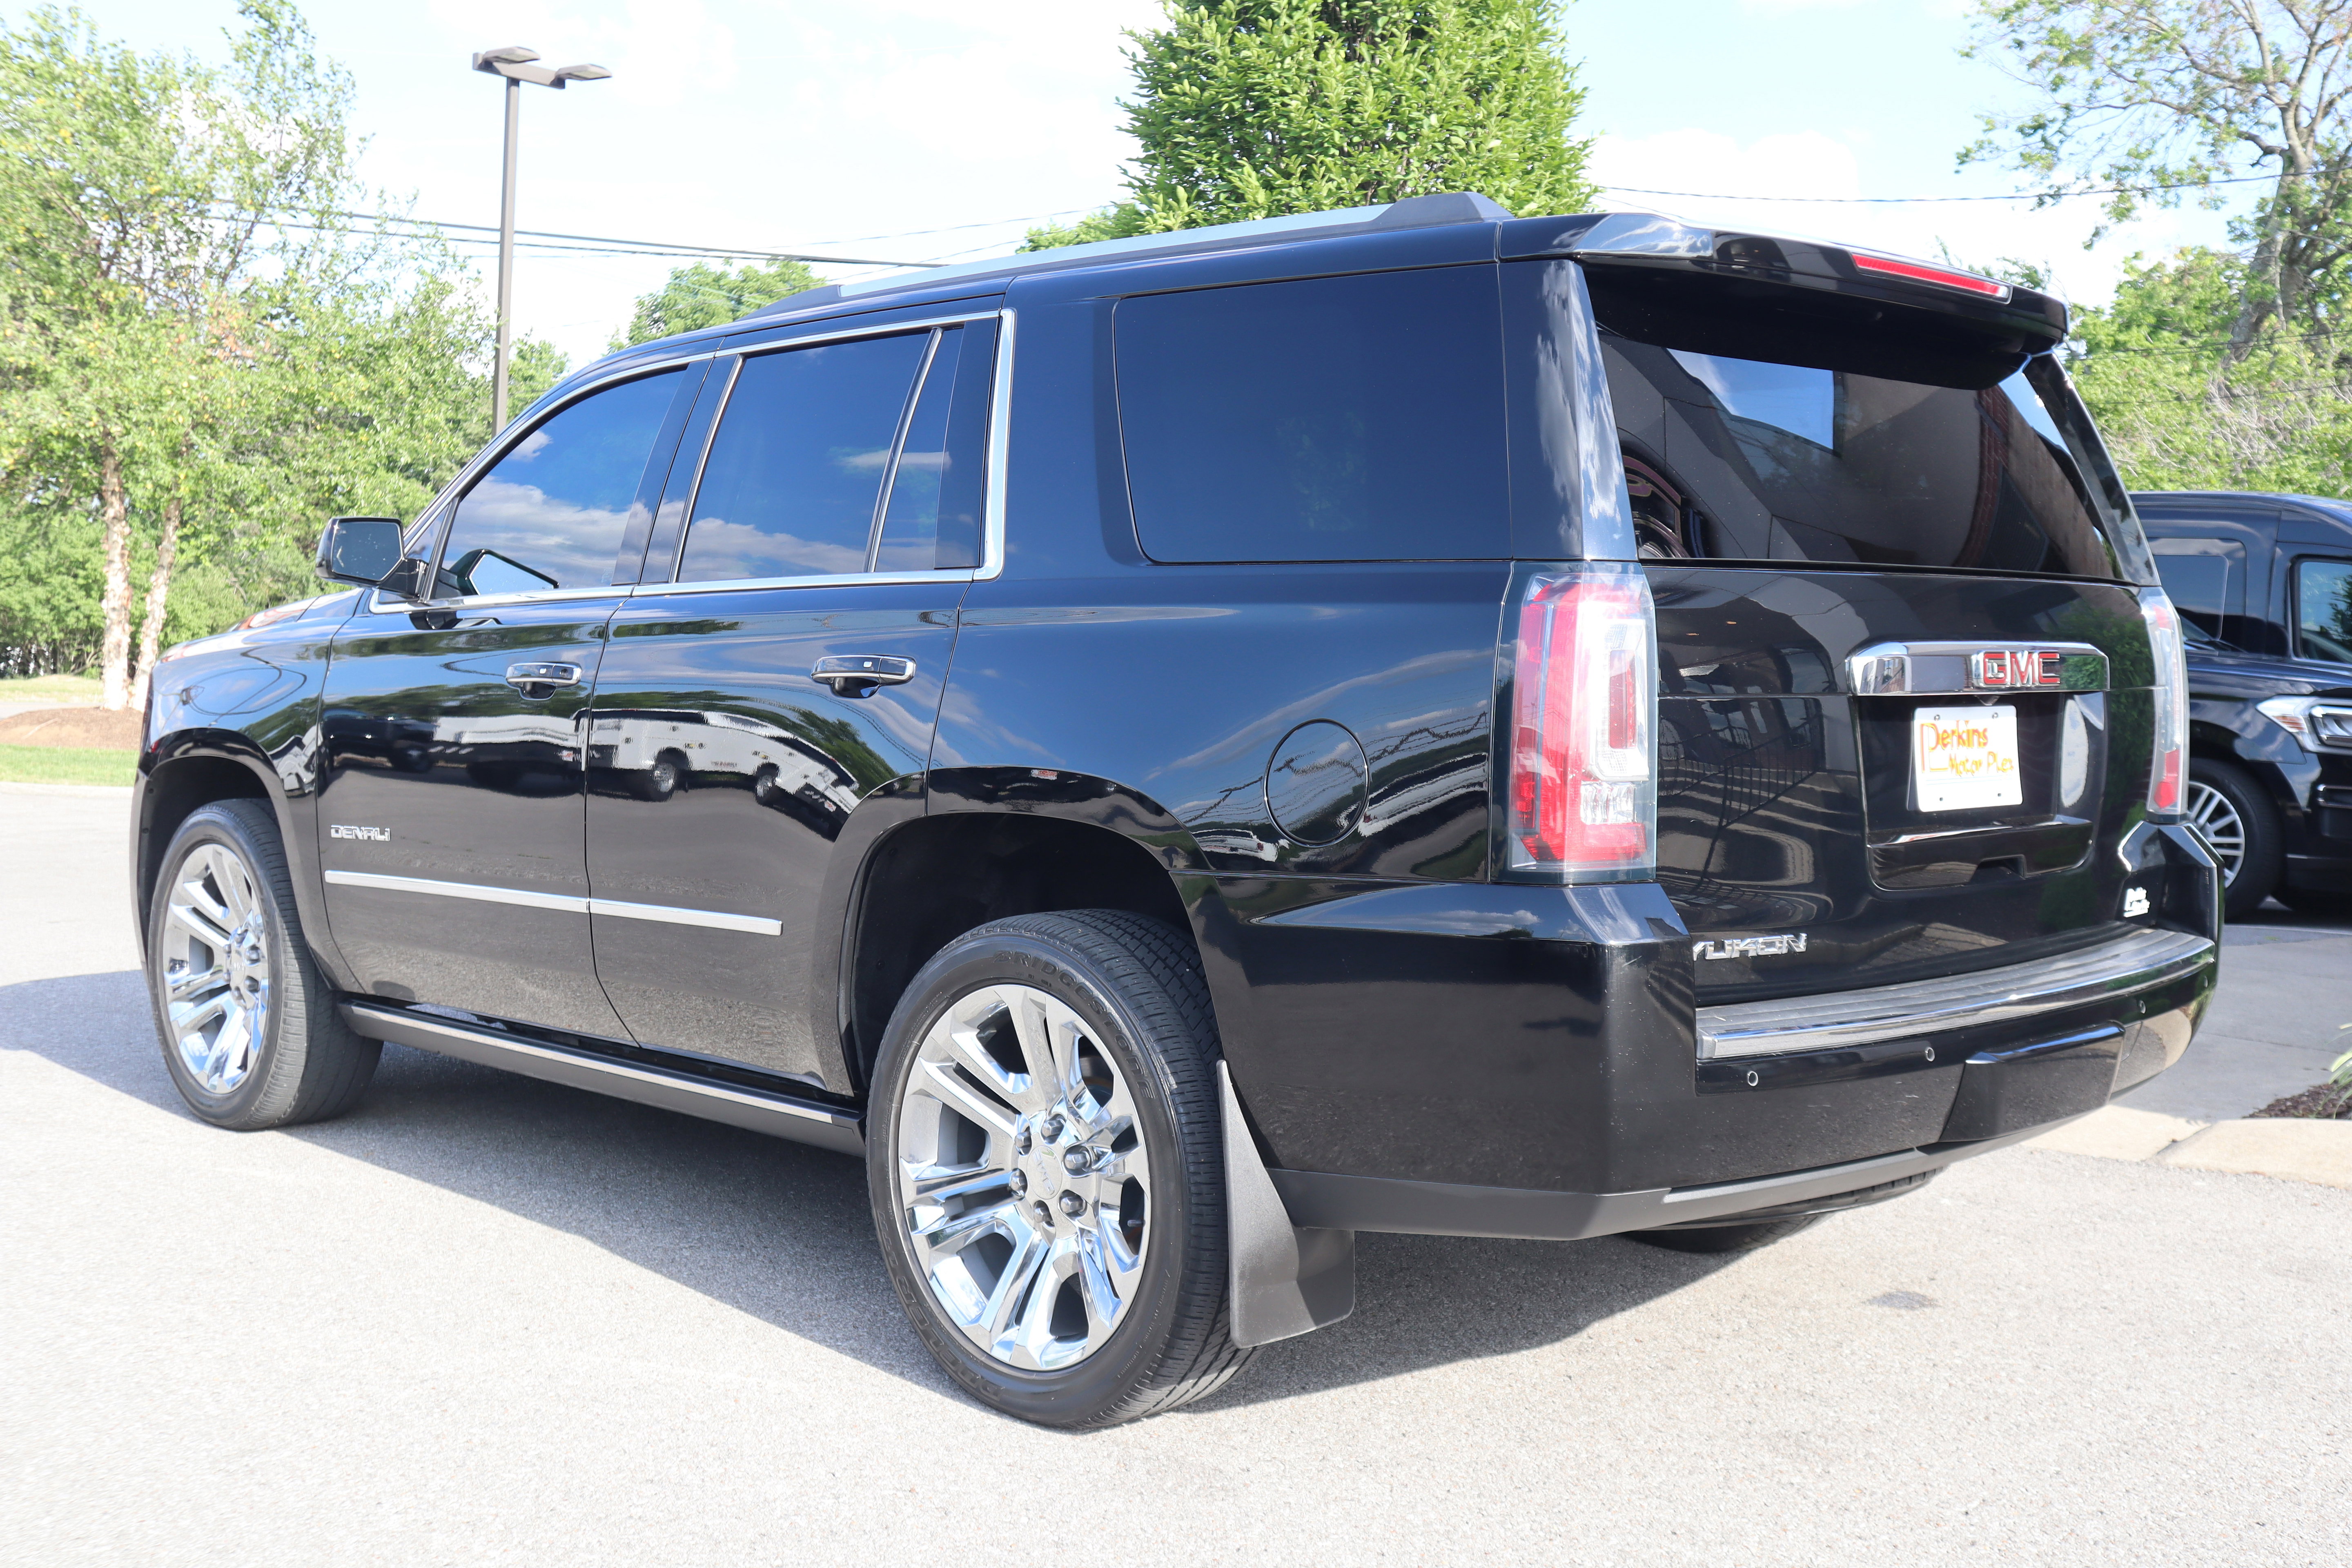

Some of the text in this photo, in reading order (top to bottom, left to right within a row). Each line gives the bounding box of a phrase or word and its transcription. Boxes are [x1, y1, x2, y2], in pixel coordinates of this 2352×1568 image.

[1977, 650, 2060, 688] GMC
[1920, 719, 1988, 773] Perkins
[331, 824, 390, 842] DENALI
